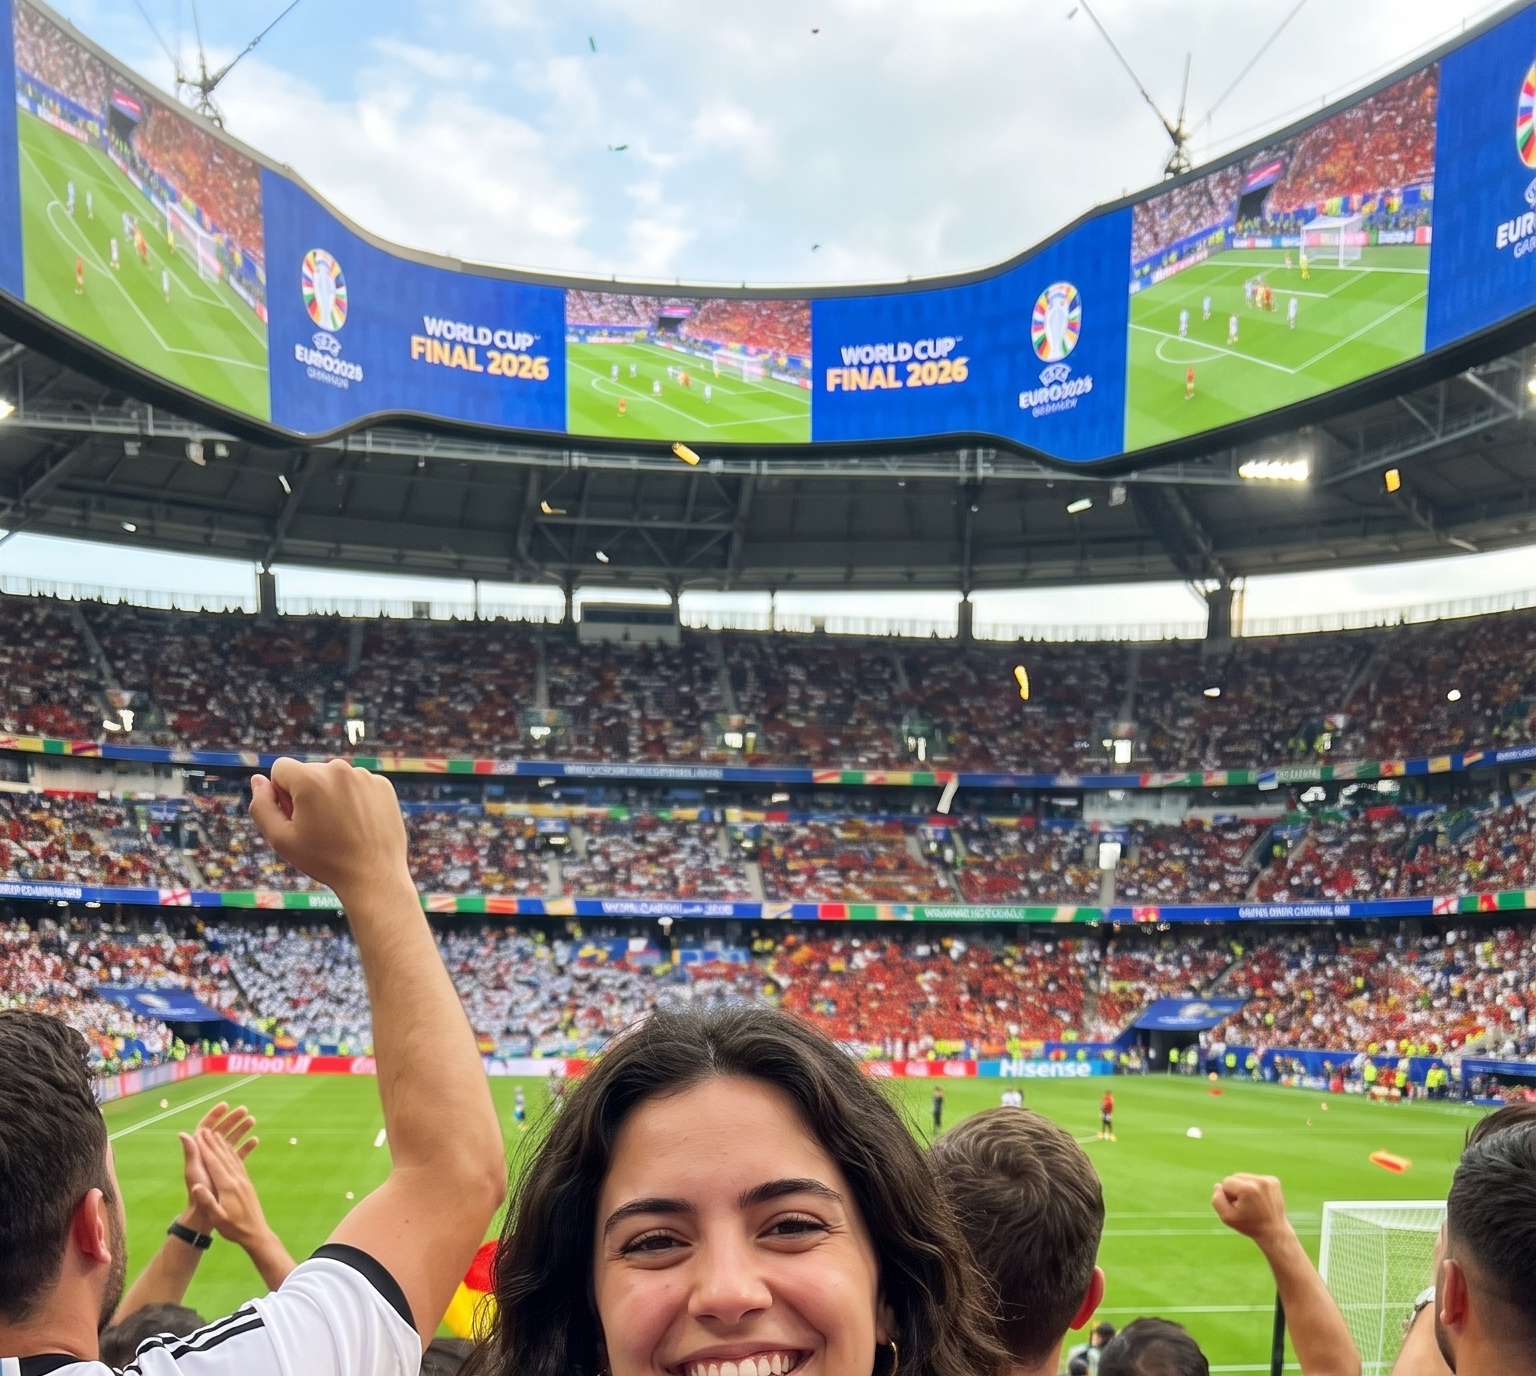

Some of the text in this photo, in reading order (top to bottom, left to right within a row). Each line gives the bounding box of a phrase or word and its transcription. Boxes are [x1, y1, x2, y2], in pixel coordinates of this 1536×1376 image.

[1496, 211, 1536, 249] EUR
[423, 315, 534, 351] WORLD CUP
[841, 336, 956, 366] WORLD CUP
[411, 334, 549, 381] FINAL 2026
[827, 356, 969, 392] FINAL 2026
